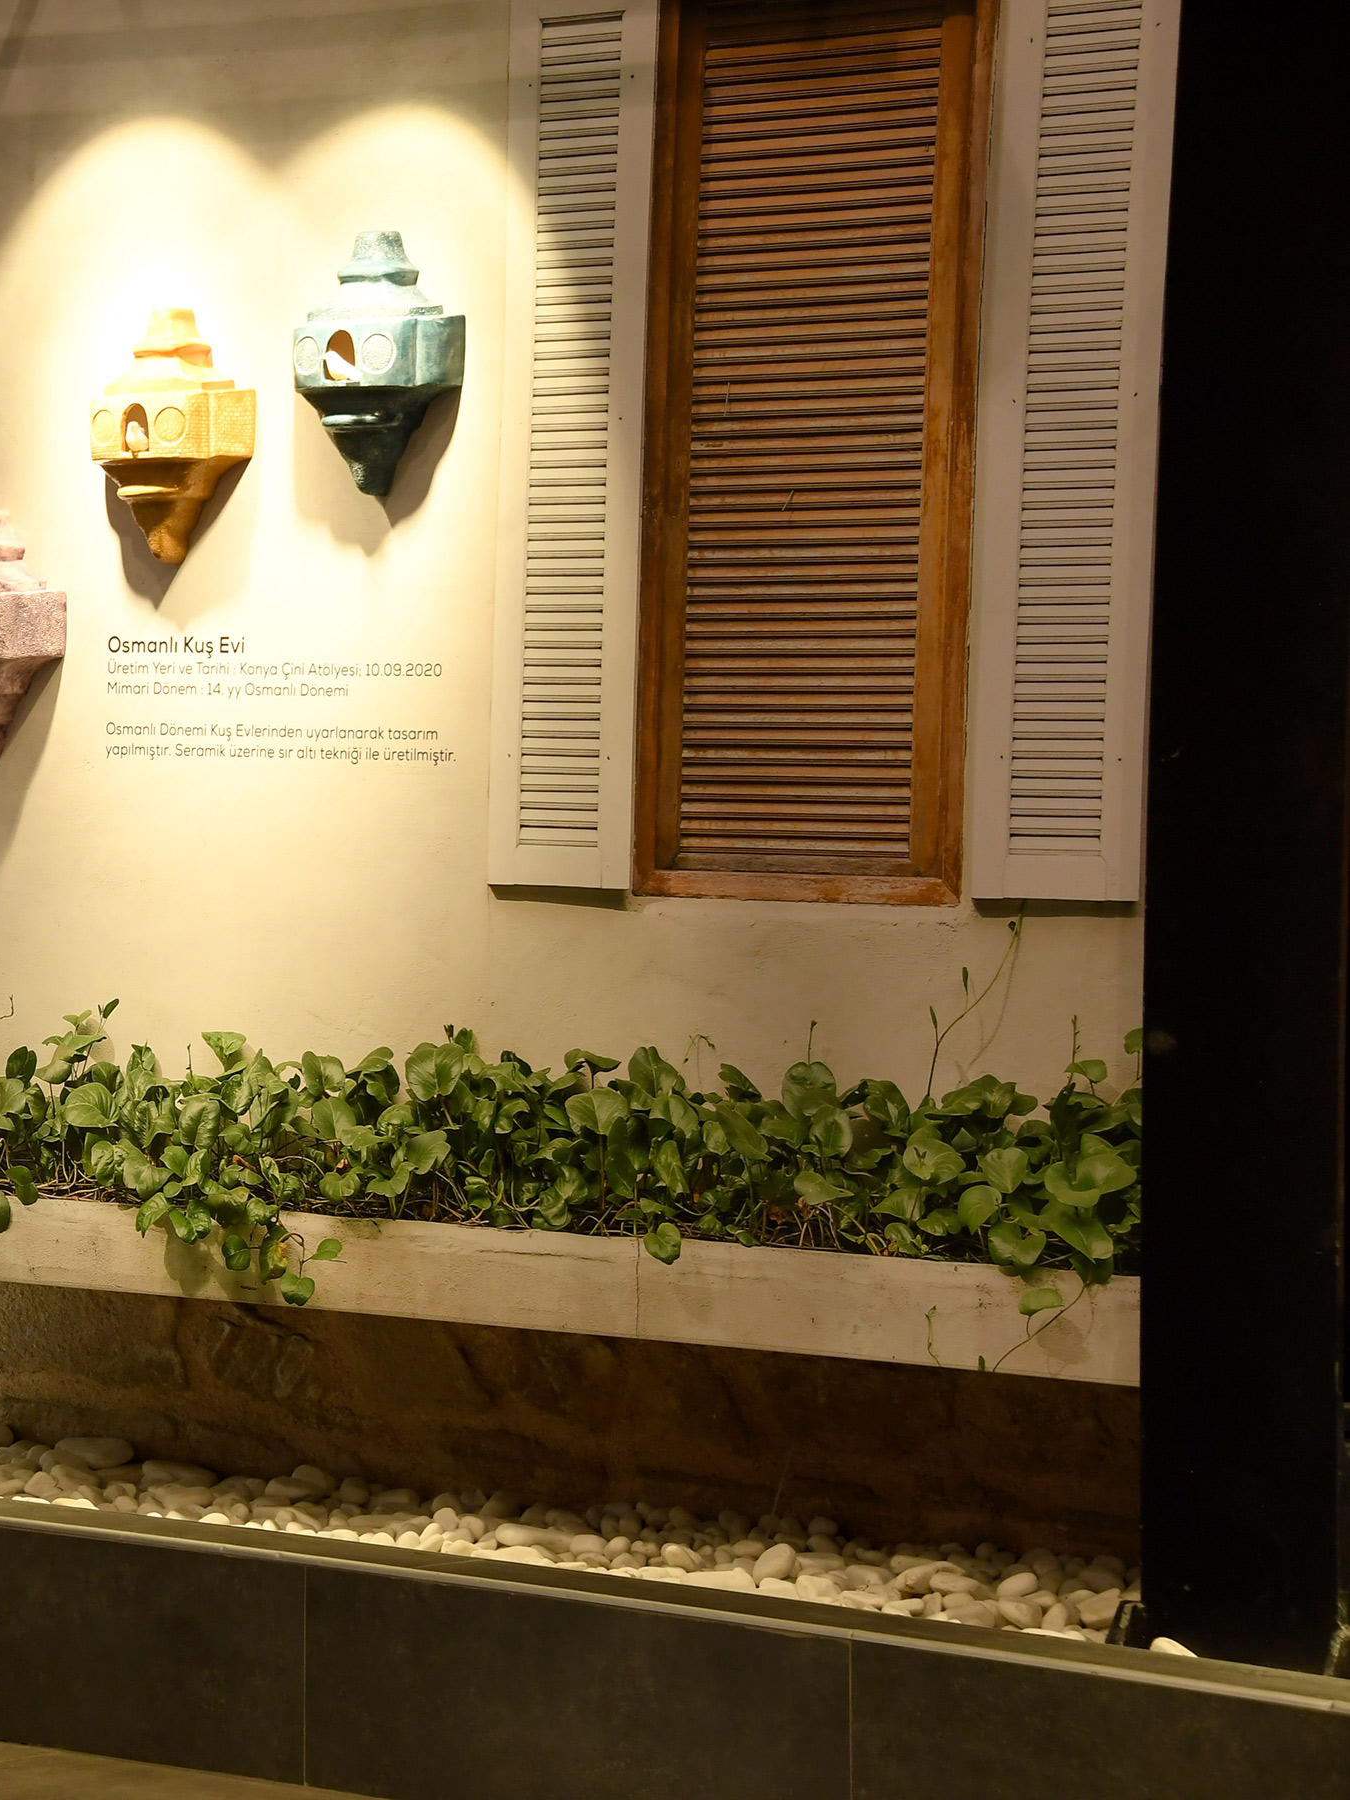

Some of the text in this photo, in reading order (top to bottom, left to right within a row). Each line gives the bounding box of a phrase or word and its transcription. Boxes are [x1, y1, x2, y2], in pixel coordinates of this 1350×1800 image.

[108, 636, 244, 659] Osmanlı Kuş Evi
[107, 658, 149, 674] Üretim
[152, 661, 175, 674] Yeri
[179, 665, 193, 675] ve
[196, 662, 229, 675] Tarihi
[240, 662, 278, 680] Konya
[282, 662, 306, 680] Çini
[366, 663, 442, 677] 10.09.2020
[107, 681, 149, 694] Mimari
[154, 682, 197, 695] Dönem
[208, 683, 223, 695] 14.
[227, 686, 242, 699] yy
[245, 683, 296, 696] Osmanlı
[300, 683, 348, 696] Dönemi
[106, 722, 438, 742] Osmanlı Dönemi Kuş Evlerinden uyarlanarak tasarım
[106, 743, 456, 766] yapılmıştır. Seramik üzerine sır altı tekniği ile üretilmiştir.
